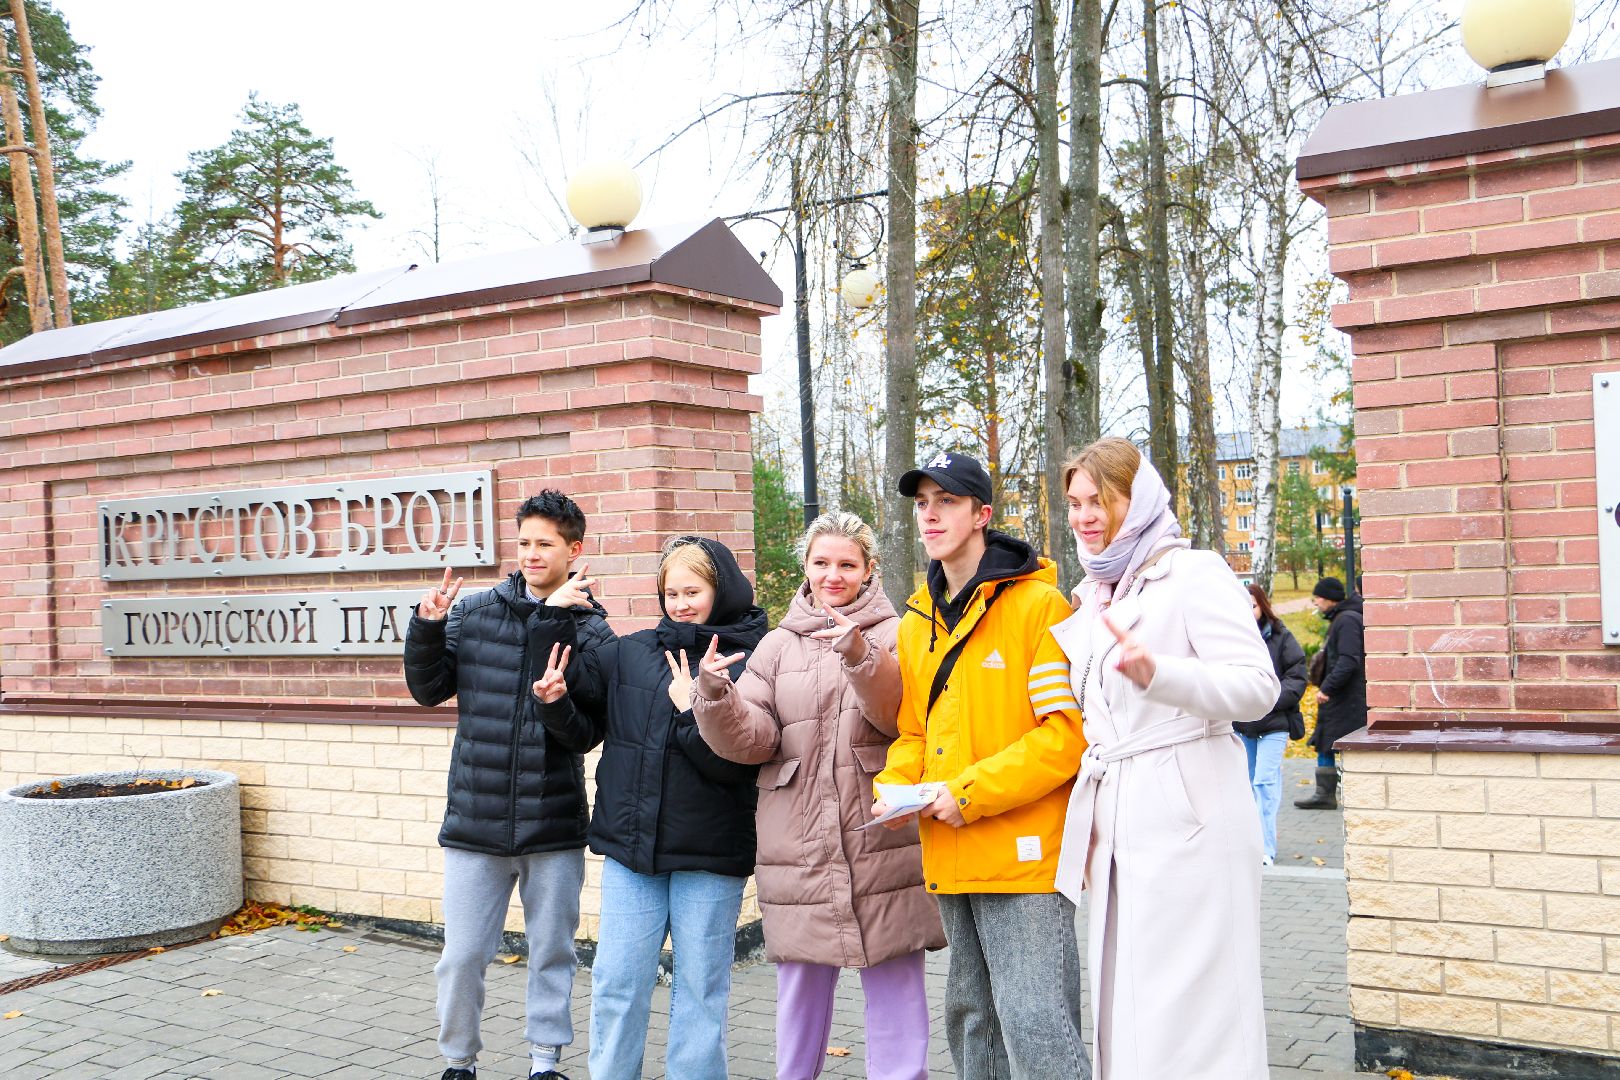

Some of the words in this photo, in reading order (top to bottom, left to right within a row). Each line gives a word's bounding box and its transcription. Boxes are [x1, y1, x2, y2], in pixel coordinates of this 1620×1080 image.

[104, 498, 318, 568] КРЕСТОВ
[336, 486, 483, 562] БРОД
[124, 600, 318, 648] ГОРОДСКОЙ
[340, 605, 416, 644] ПА
